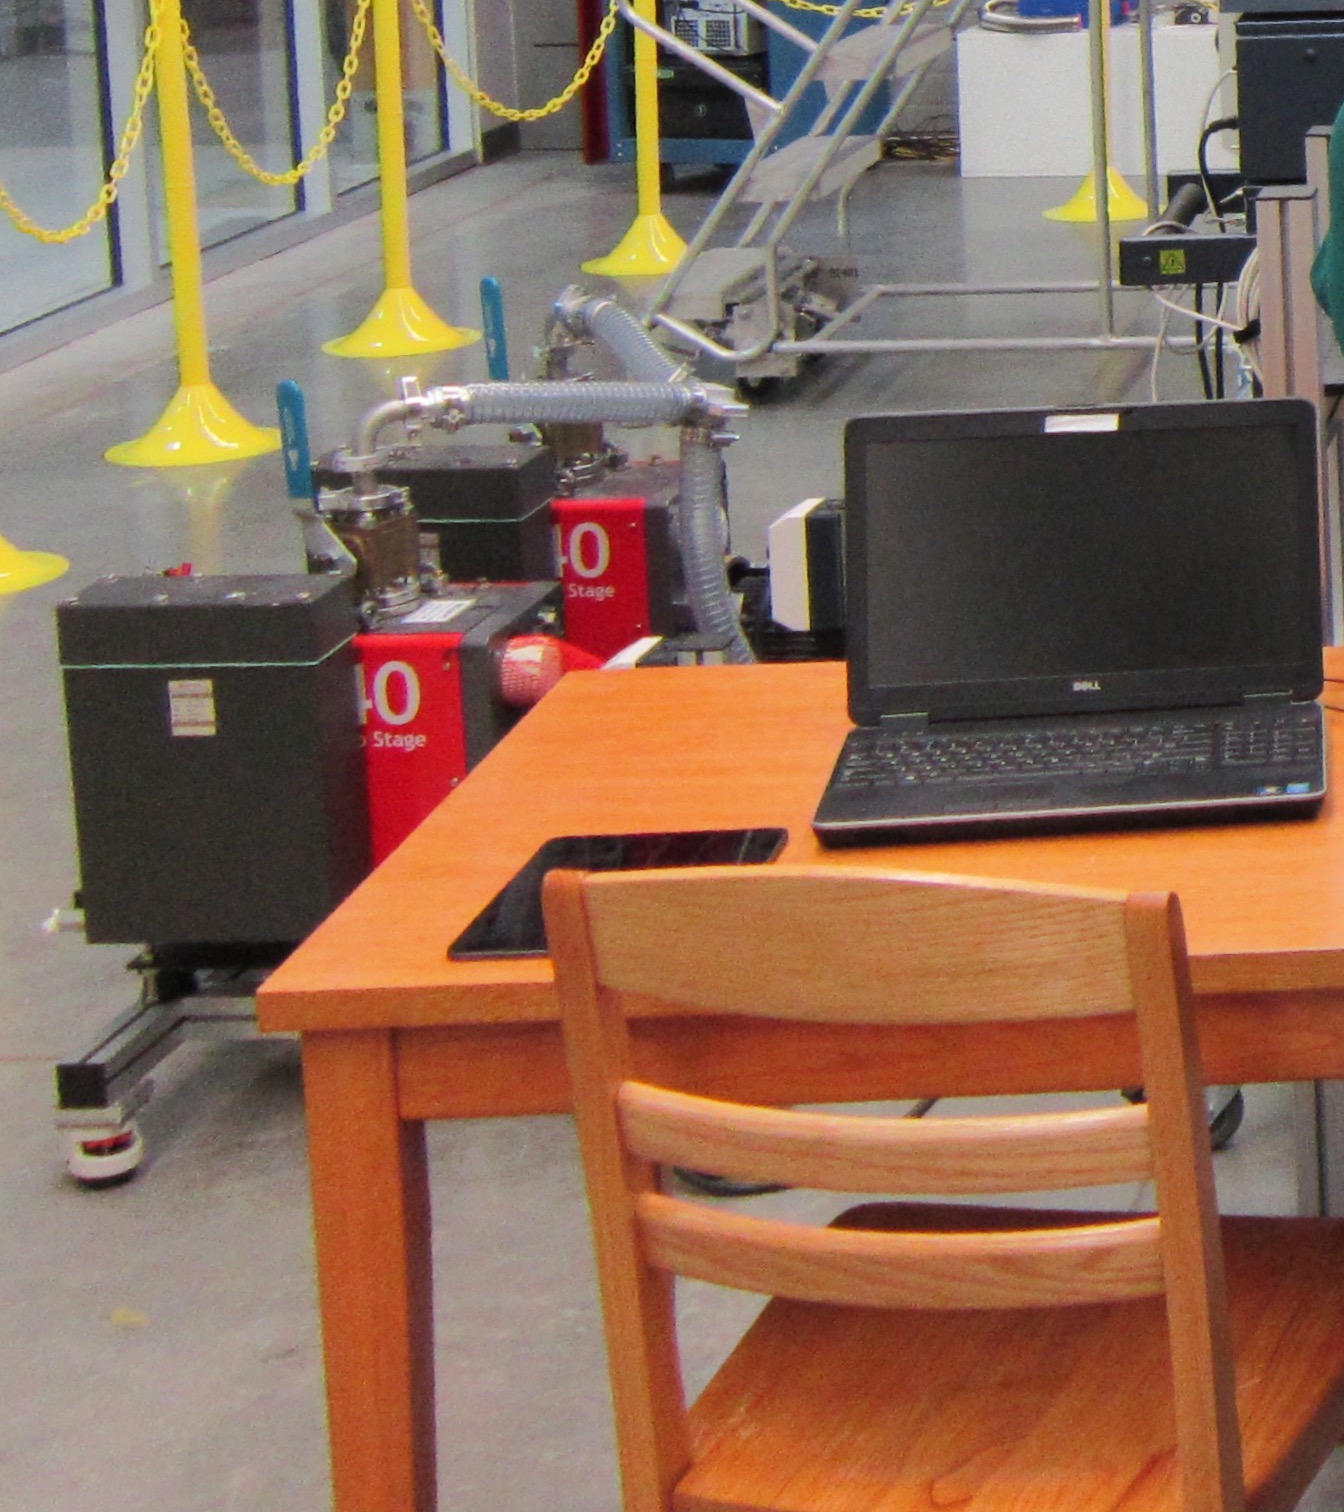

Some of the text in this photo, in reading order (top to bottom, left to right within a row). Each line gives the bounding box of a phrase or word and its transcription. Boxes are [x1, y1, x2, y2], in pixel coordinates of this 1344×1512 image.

[568, 583, 616, 601] Stage
[1073, 680, 1102, 691] DELL
[373, 731, 428, 752] Stage
